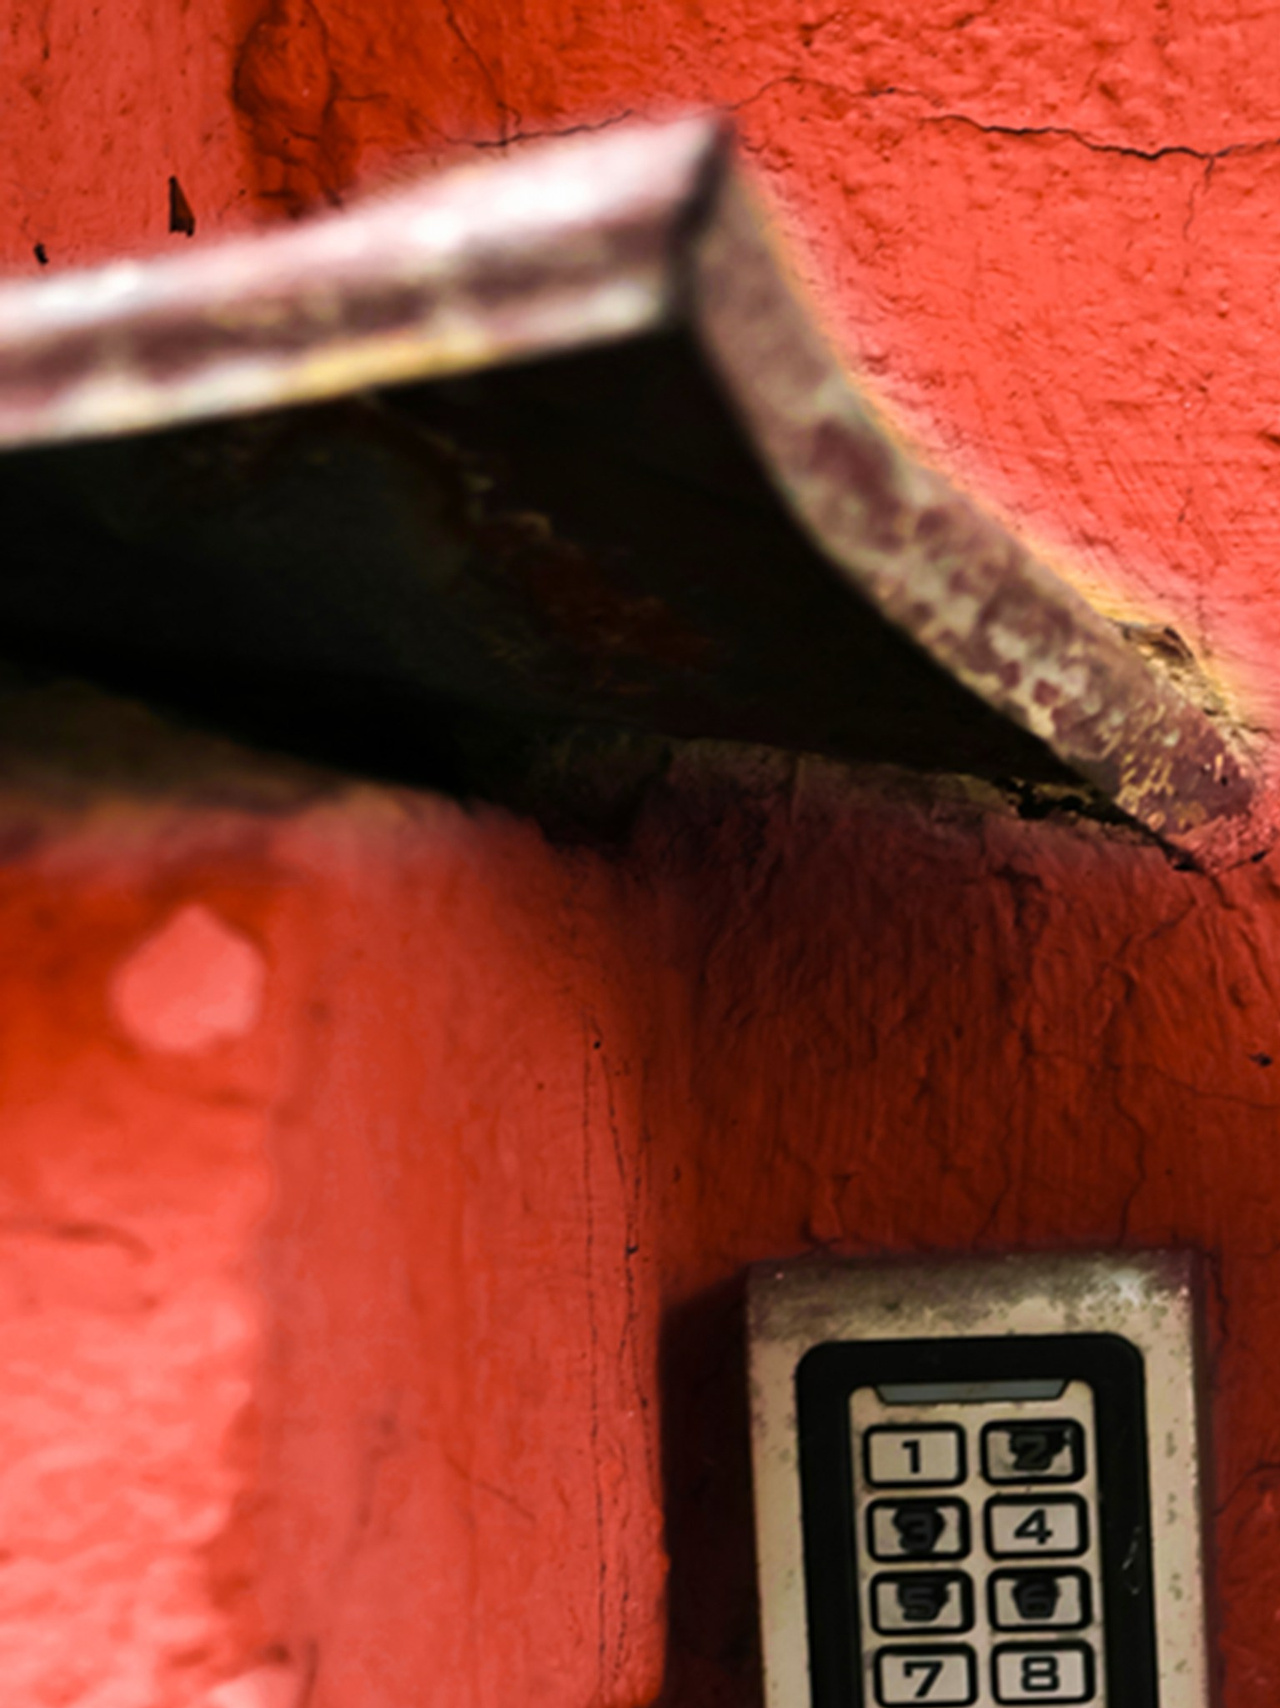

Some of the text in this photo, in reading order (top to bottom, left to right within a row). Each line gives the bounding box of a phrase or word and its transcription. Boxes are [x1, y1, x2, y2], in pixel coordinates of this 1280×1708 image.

[902, 1440, 921, 1474] 1
[1013, 1508, 1053, 1545] 4
[903, 1655, 1060, 1698] 7 8
